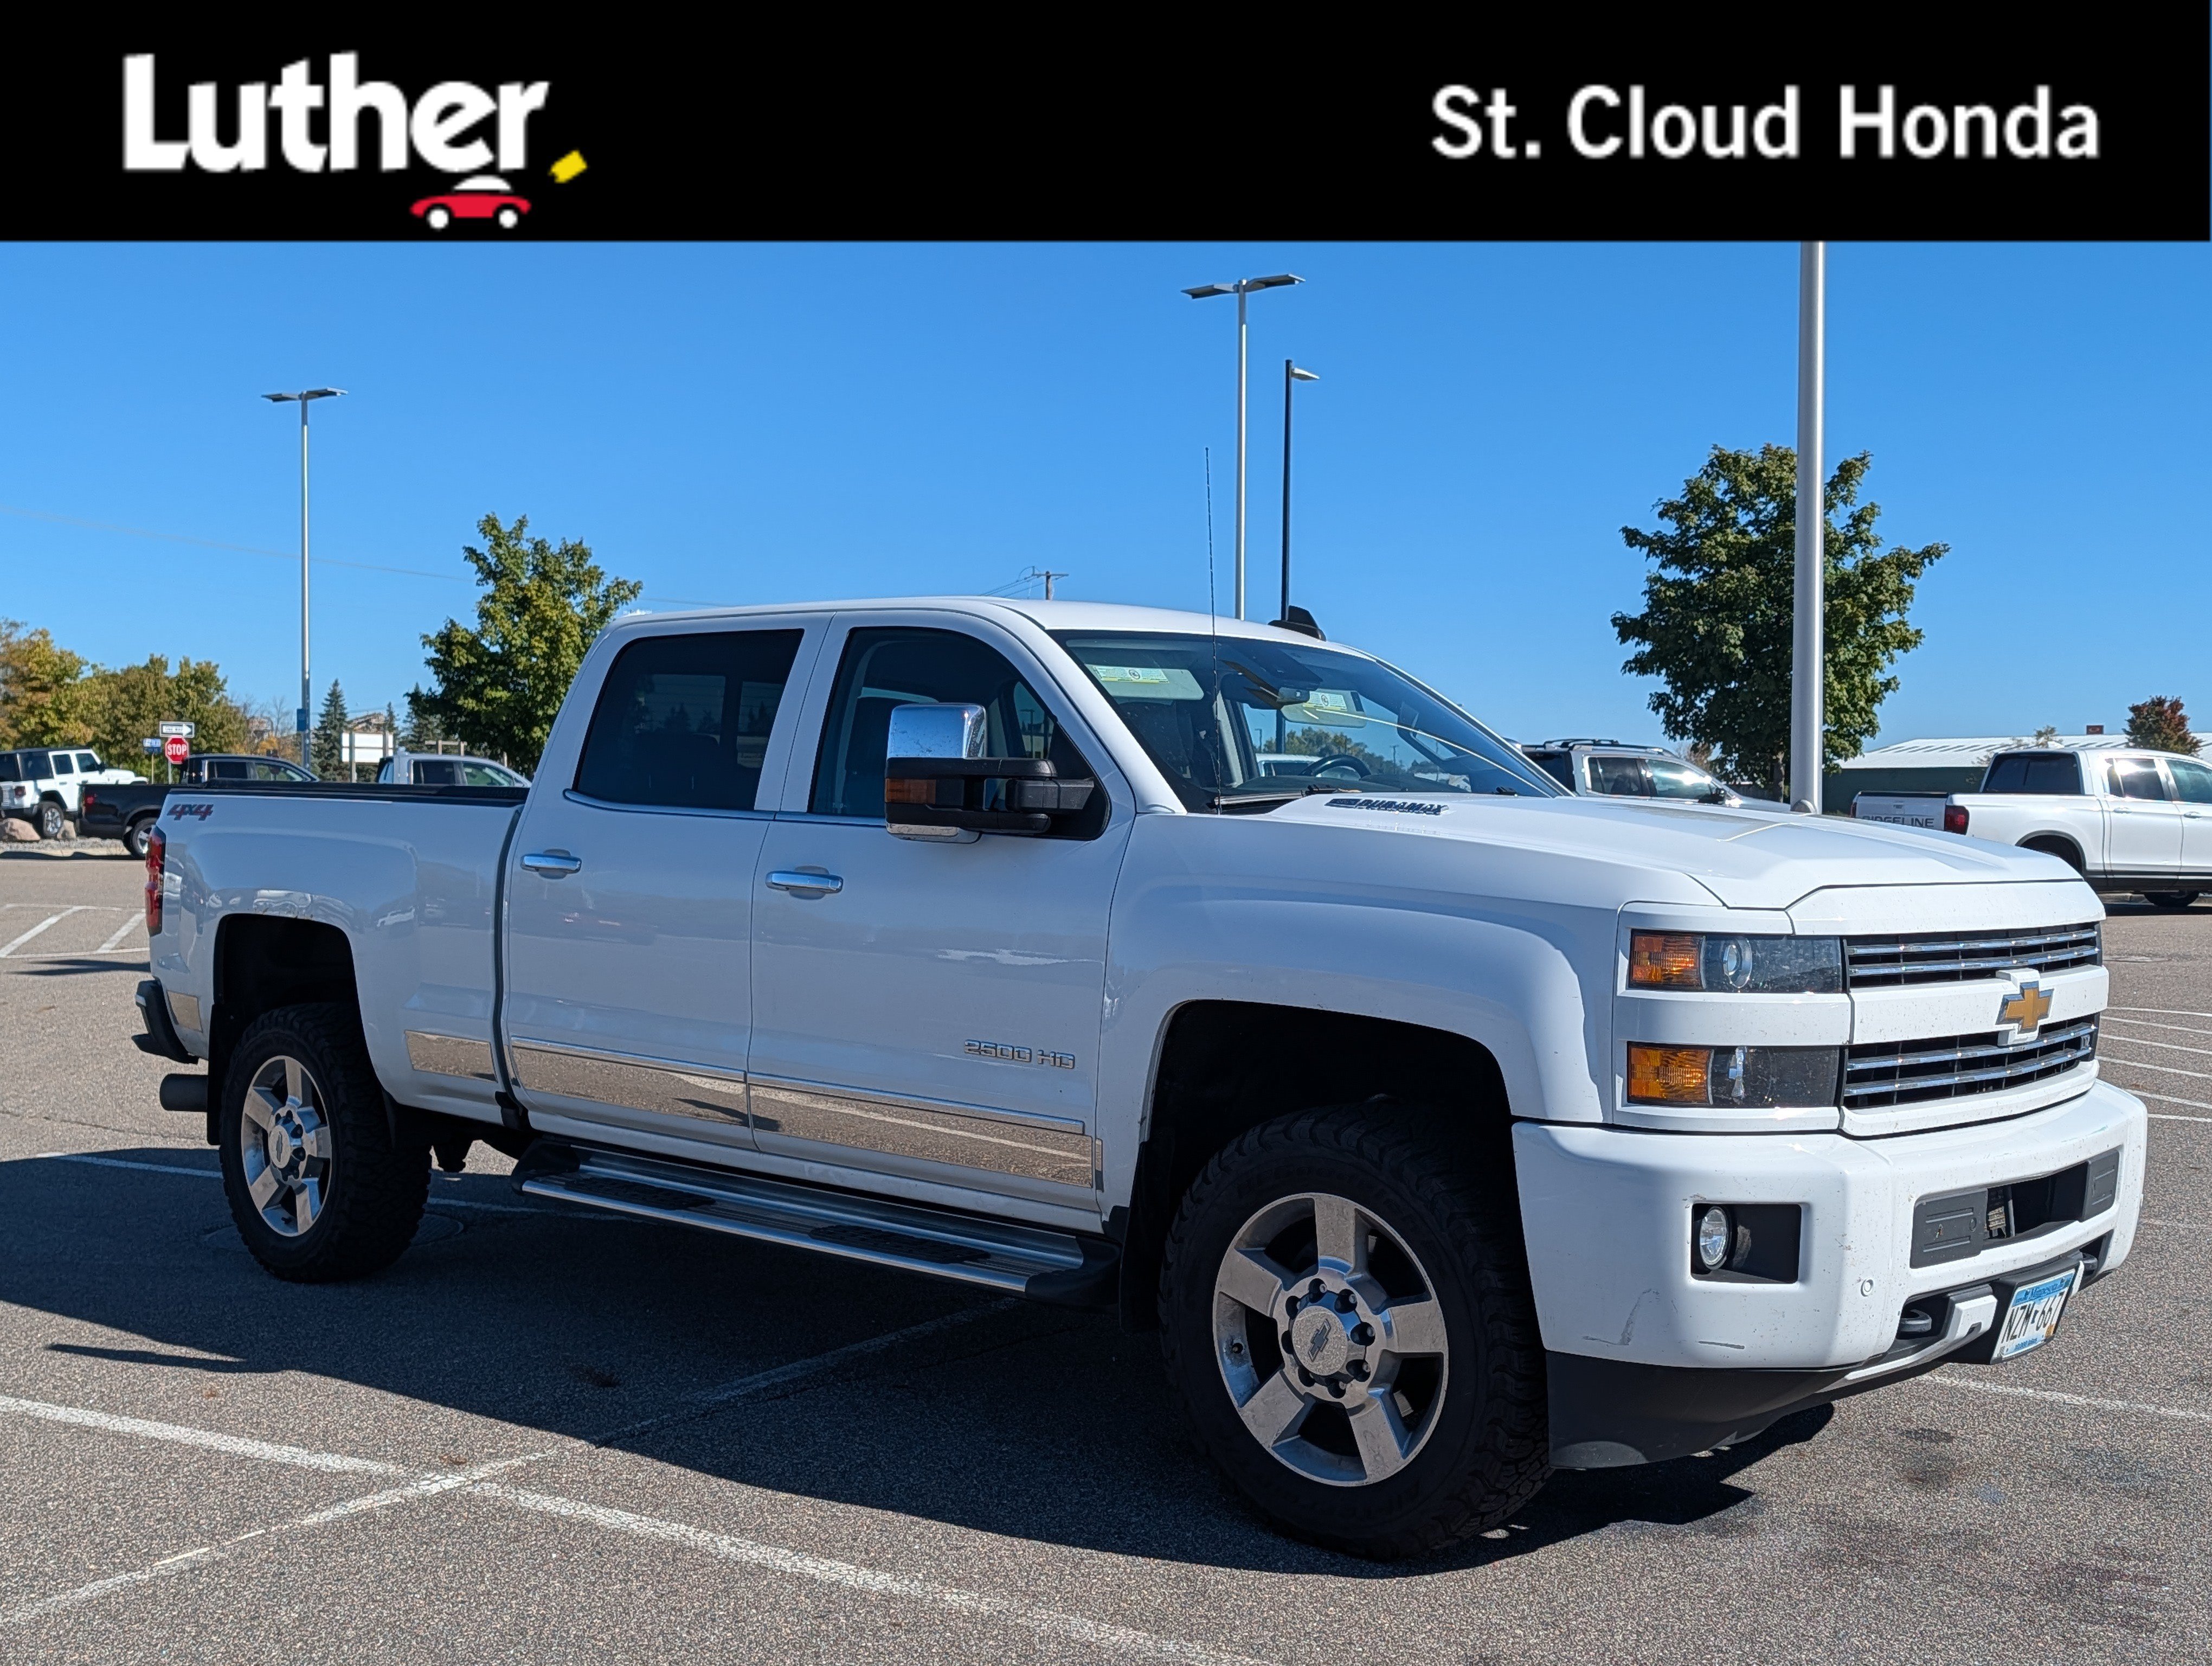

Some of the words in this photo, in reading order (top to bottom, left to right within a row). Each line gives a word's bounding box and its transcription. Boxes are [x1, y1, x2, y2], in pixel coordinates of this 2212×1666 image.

[167, 744, 187, 755] STOP
[1355, 799, 1449, 815] DURAMAX
[964, 1039, 1032, 1063] 2500
[1037, 1049, 1076, 1069] HD
